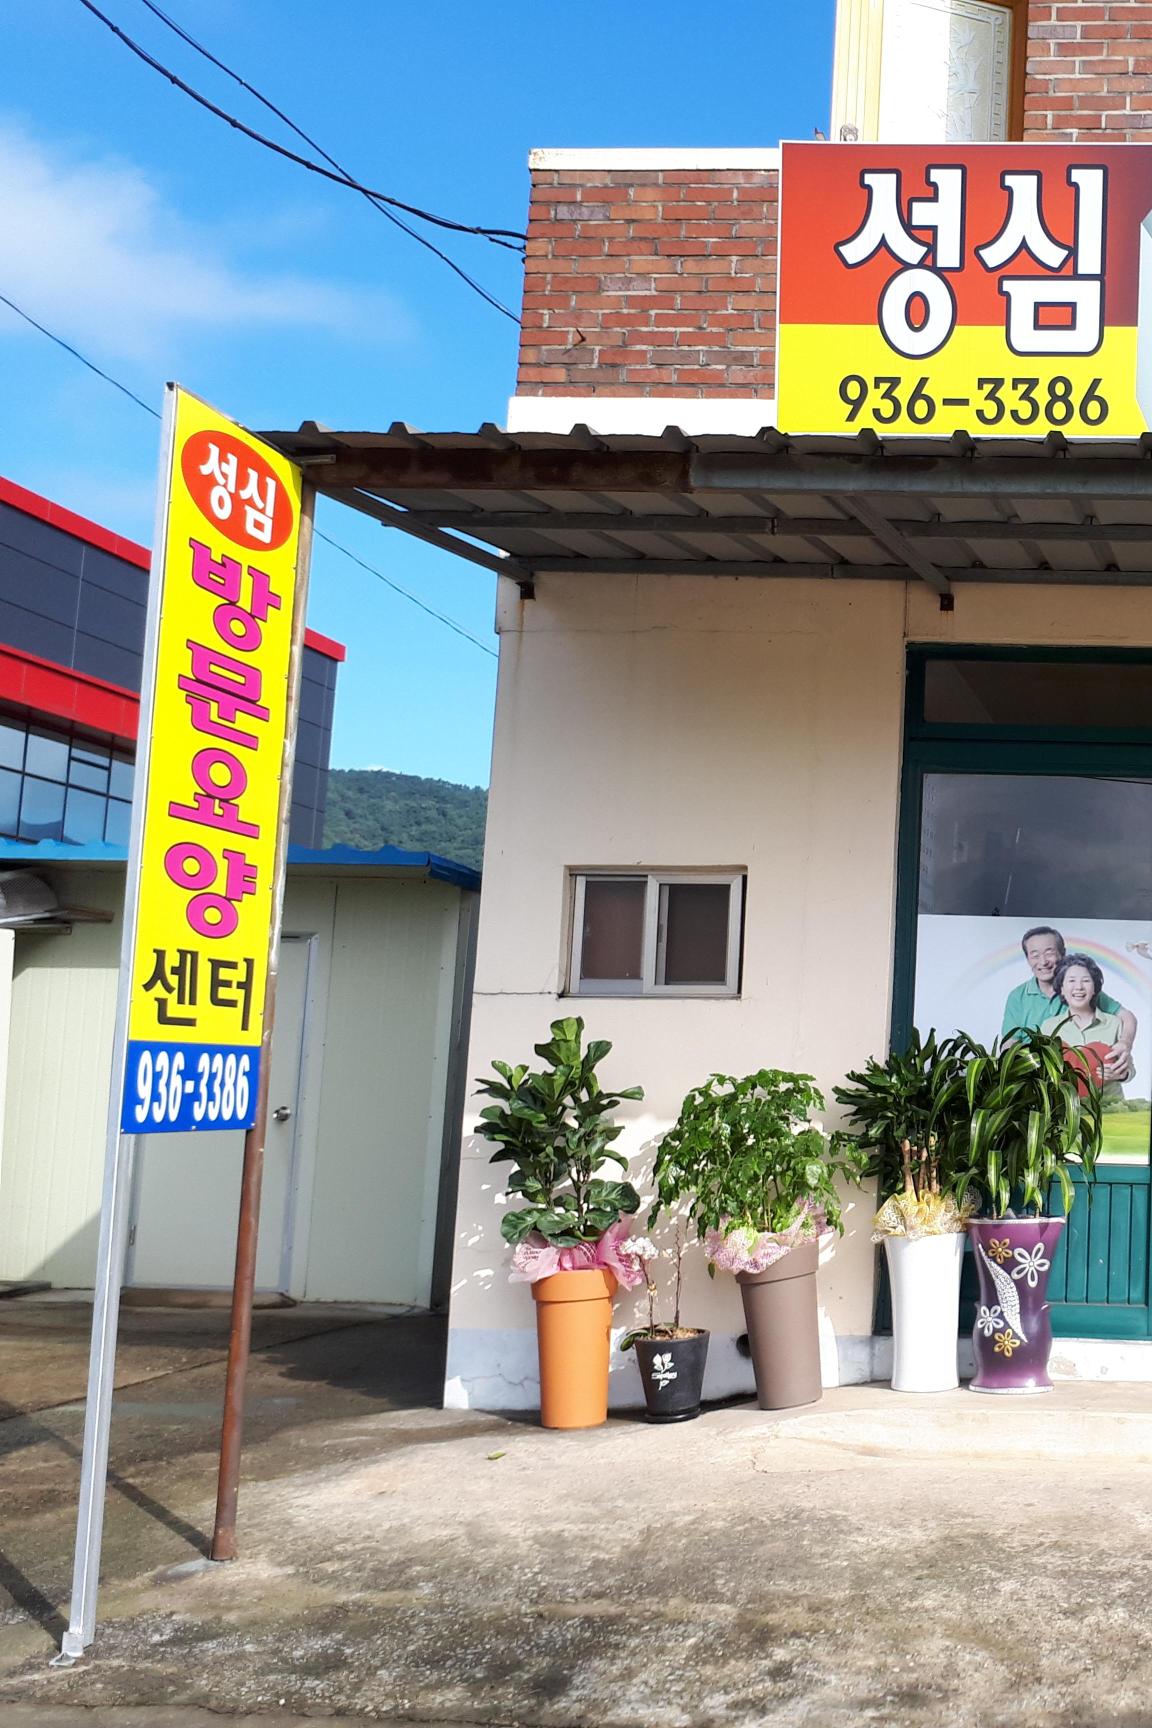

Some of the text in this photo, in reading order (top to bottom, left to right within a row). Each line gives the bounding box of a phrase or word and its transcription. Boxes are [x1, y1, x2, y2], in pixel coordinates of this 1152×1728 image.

[834, 163, 1109, 358] 성심
[839, 374, 1109, 426] 936-3386
[200, 442, 276, 544] 성심
[163, 537, 281, 939] 방문요양
[142, 948, 255, 1031] 센터
[135, 1050, 250, 1123] 936-3386
